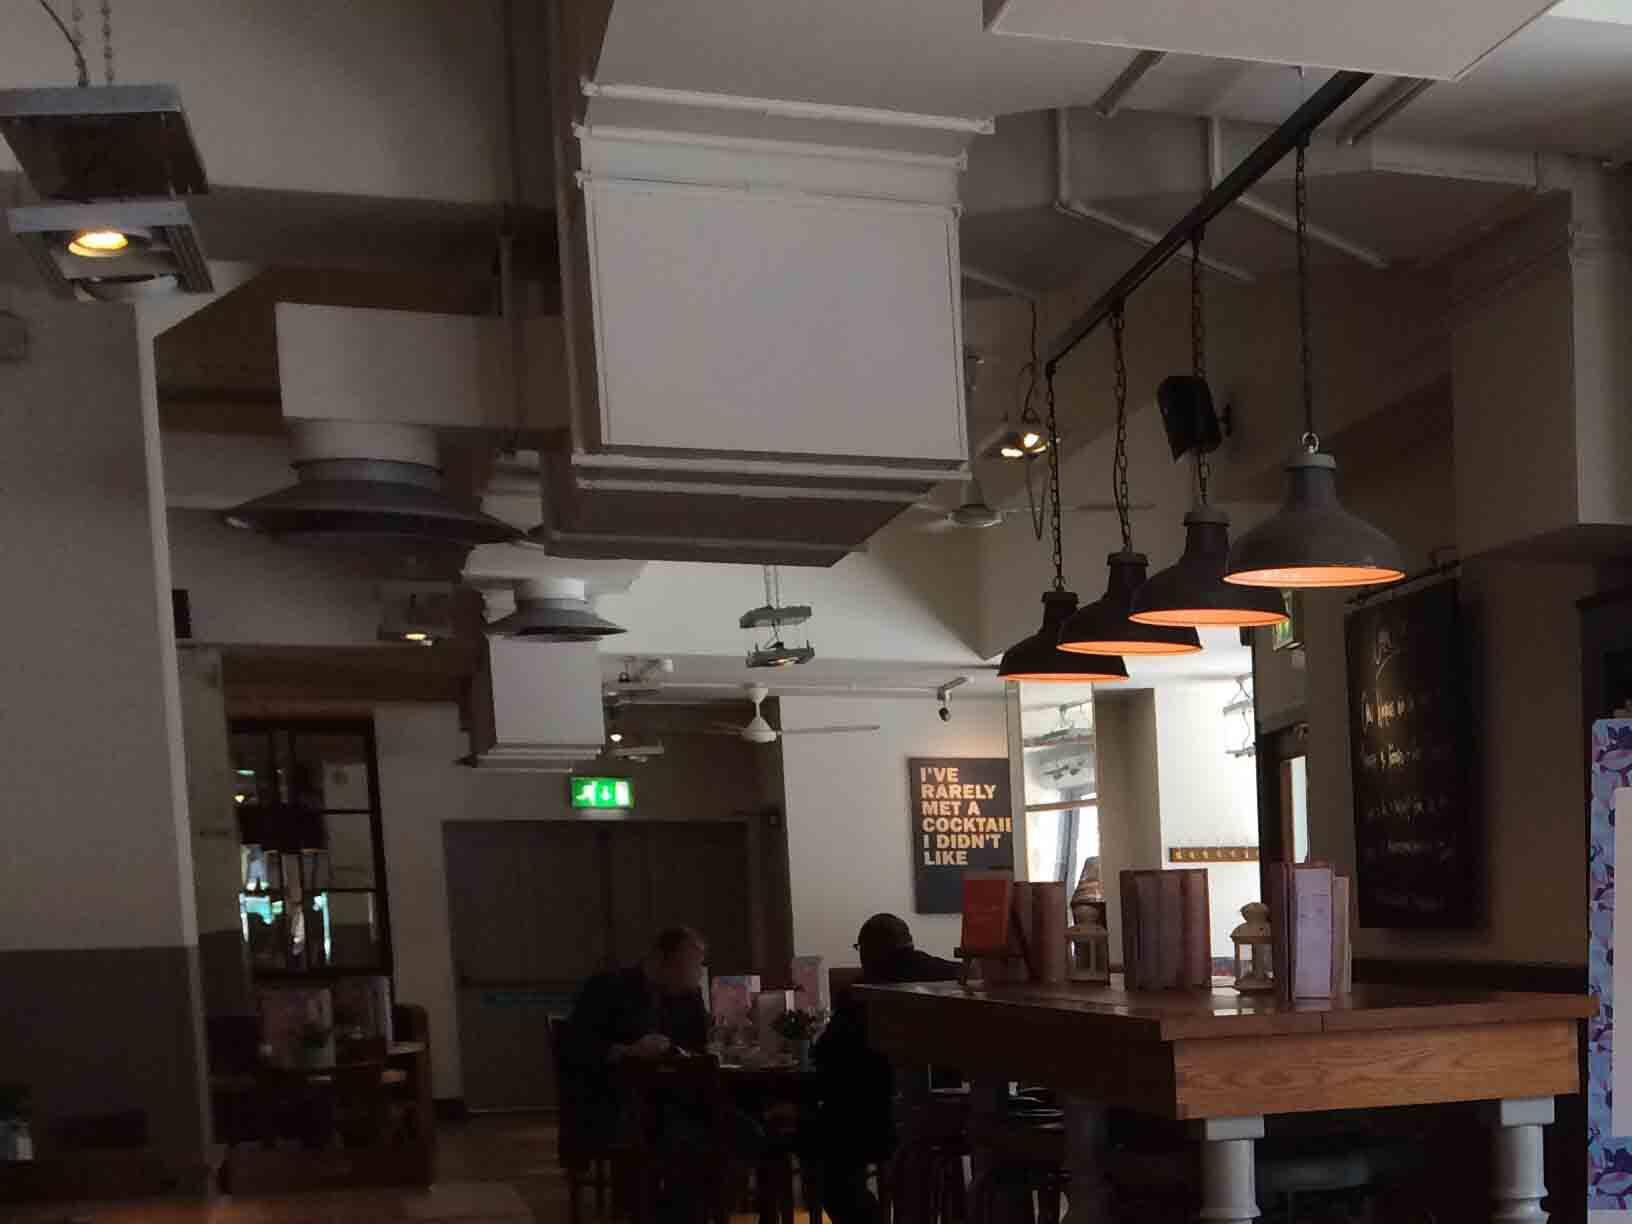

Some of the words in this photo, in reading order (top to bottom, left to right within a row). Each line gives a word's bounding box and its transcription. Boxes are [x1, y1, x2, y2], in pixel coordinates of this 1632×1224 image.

[920, 767, 960, 782] I'VE
[921, 784, 997, 799] RARELY
[921, 801, 962, 815] MET
[968, 801, 980, 815] A
[923, 834, 930, 848] I
[936, 834, 1001, 849] DIDN'T
[923, 851, 968, 865] LIKE
